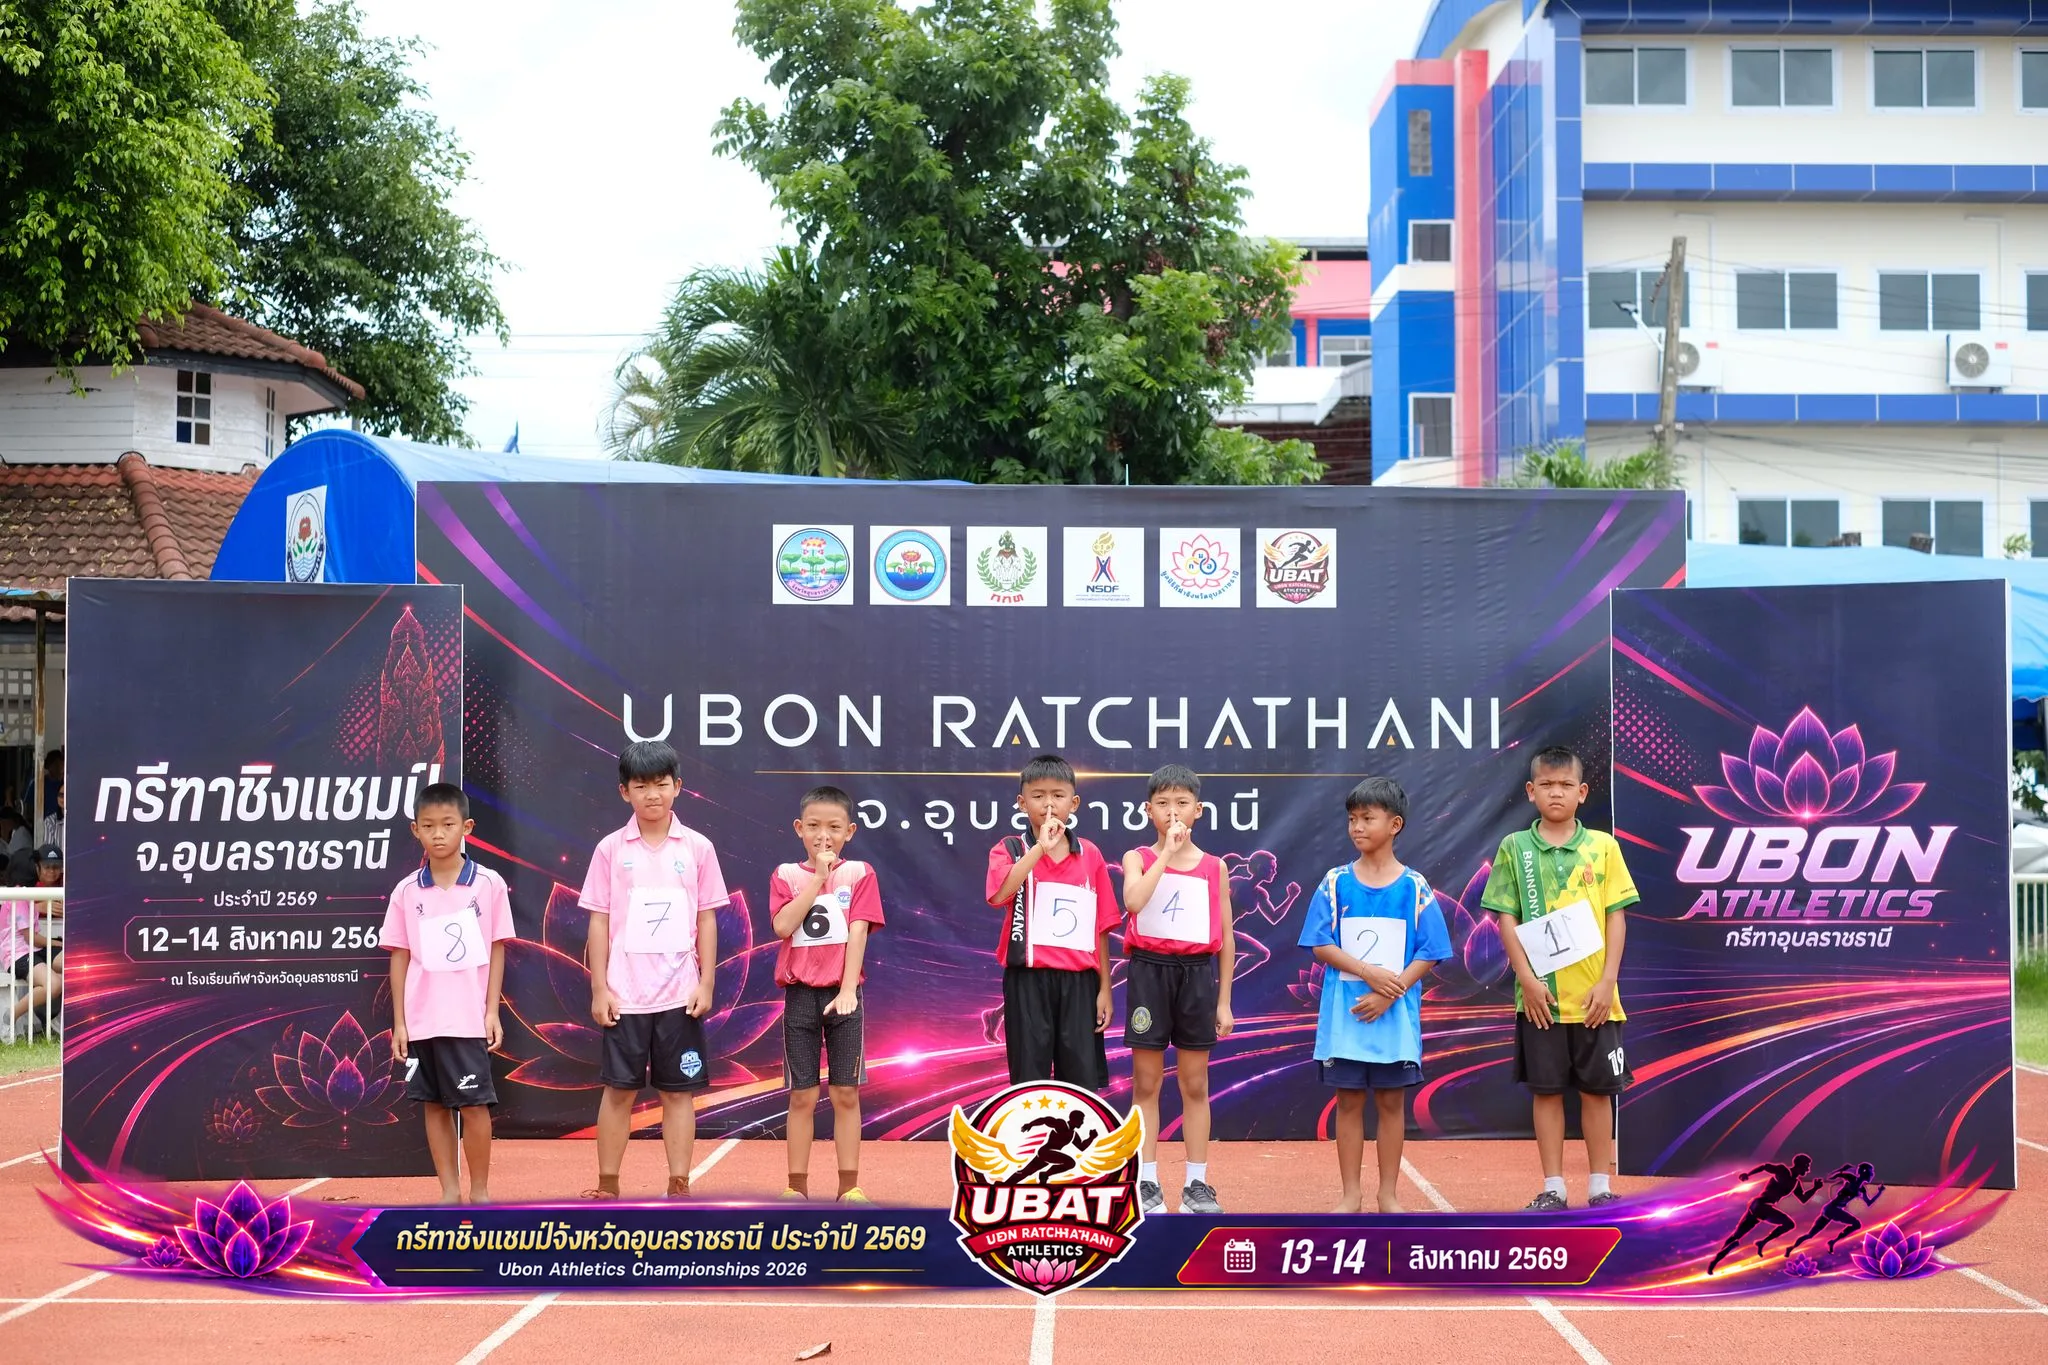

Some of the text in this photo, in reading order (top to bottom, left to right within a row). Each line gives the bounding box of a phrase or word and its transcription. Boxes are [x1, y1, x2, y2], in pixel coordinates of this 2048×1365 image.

[1086, 585, 1119, 593] NSDF
[1269, 568, 1325, 583] UBAT
[990, 593, 1024, 604] กกท
[620, 692, 1501, 750] UBON RATCHATHANI
[136, 828, 391, 884] จ.อุบลราชธานี
[1676, 826, 1958, 883] UBON
[213, 889, 318, 907] ประจำปี 2569
[1523, 850, 1540, 920] BANNONY
[645, 902, 671, 936] 7
[802, 904, 830, 938] 6
[1053, 898, 1077, 937] 5
[1161, 890, 1184, 922] 4
[1682, 889, 1942, 920] ATHLETICS
[229, 926, 322, 951] สิงหาคม
[331, 926, 381, 949] 256
[445, 923, 466, 962] 8
[1357, 929, 1383, 966] 2
[1544, 921, 1570, 957] 1
[1725, 925, 1894, 953] กรีฑาอุบลราชธานี
[171, 969, 359, 988] ณ โรงเรียนกีฬาจังหวัดอุบลราชธานี
[1608, 1047, 1624, 1076] 19
